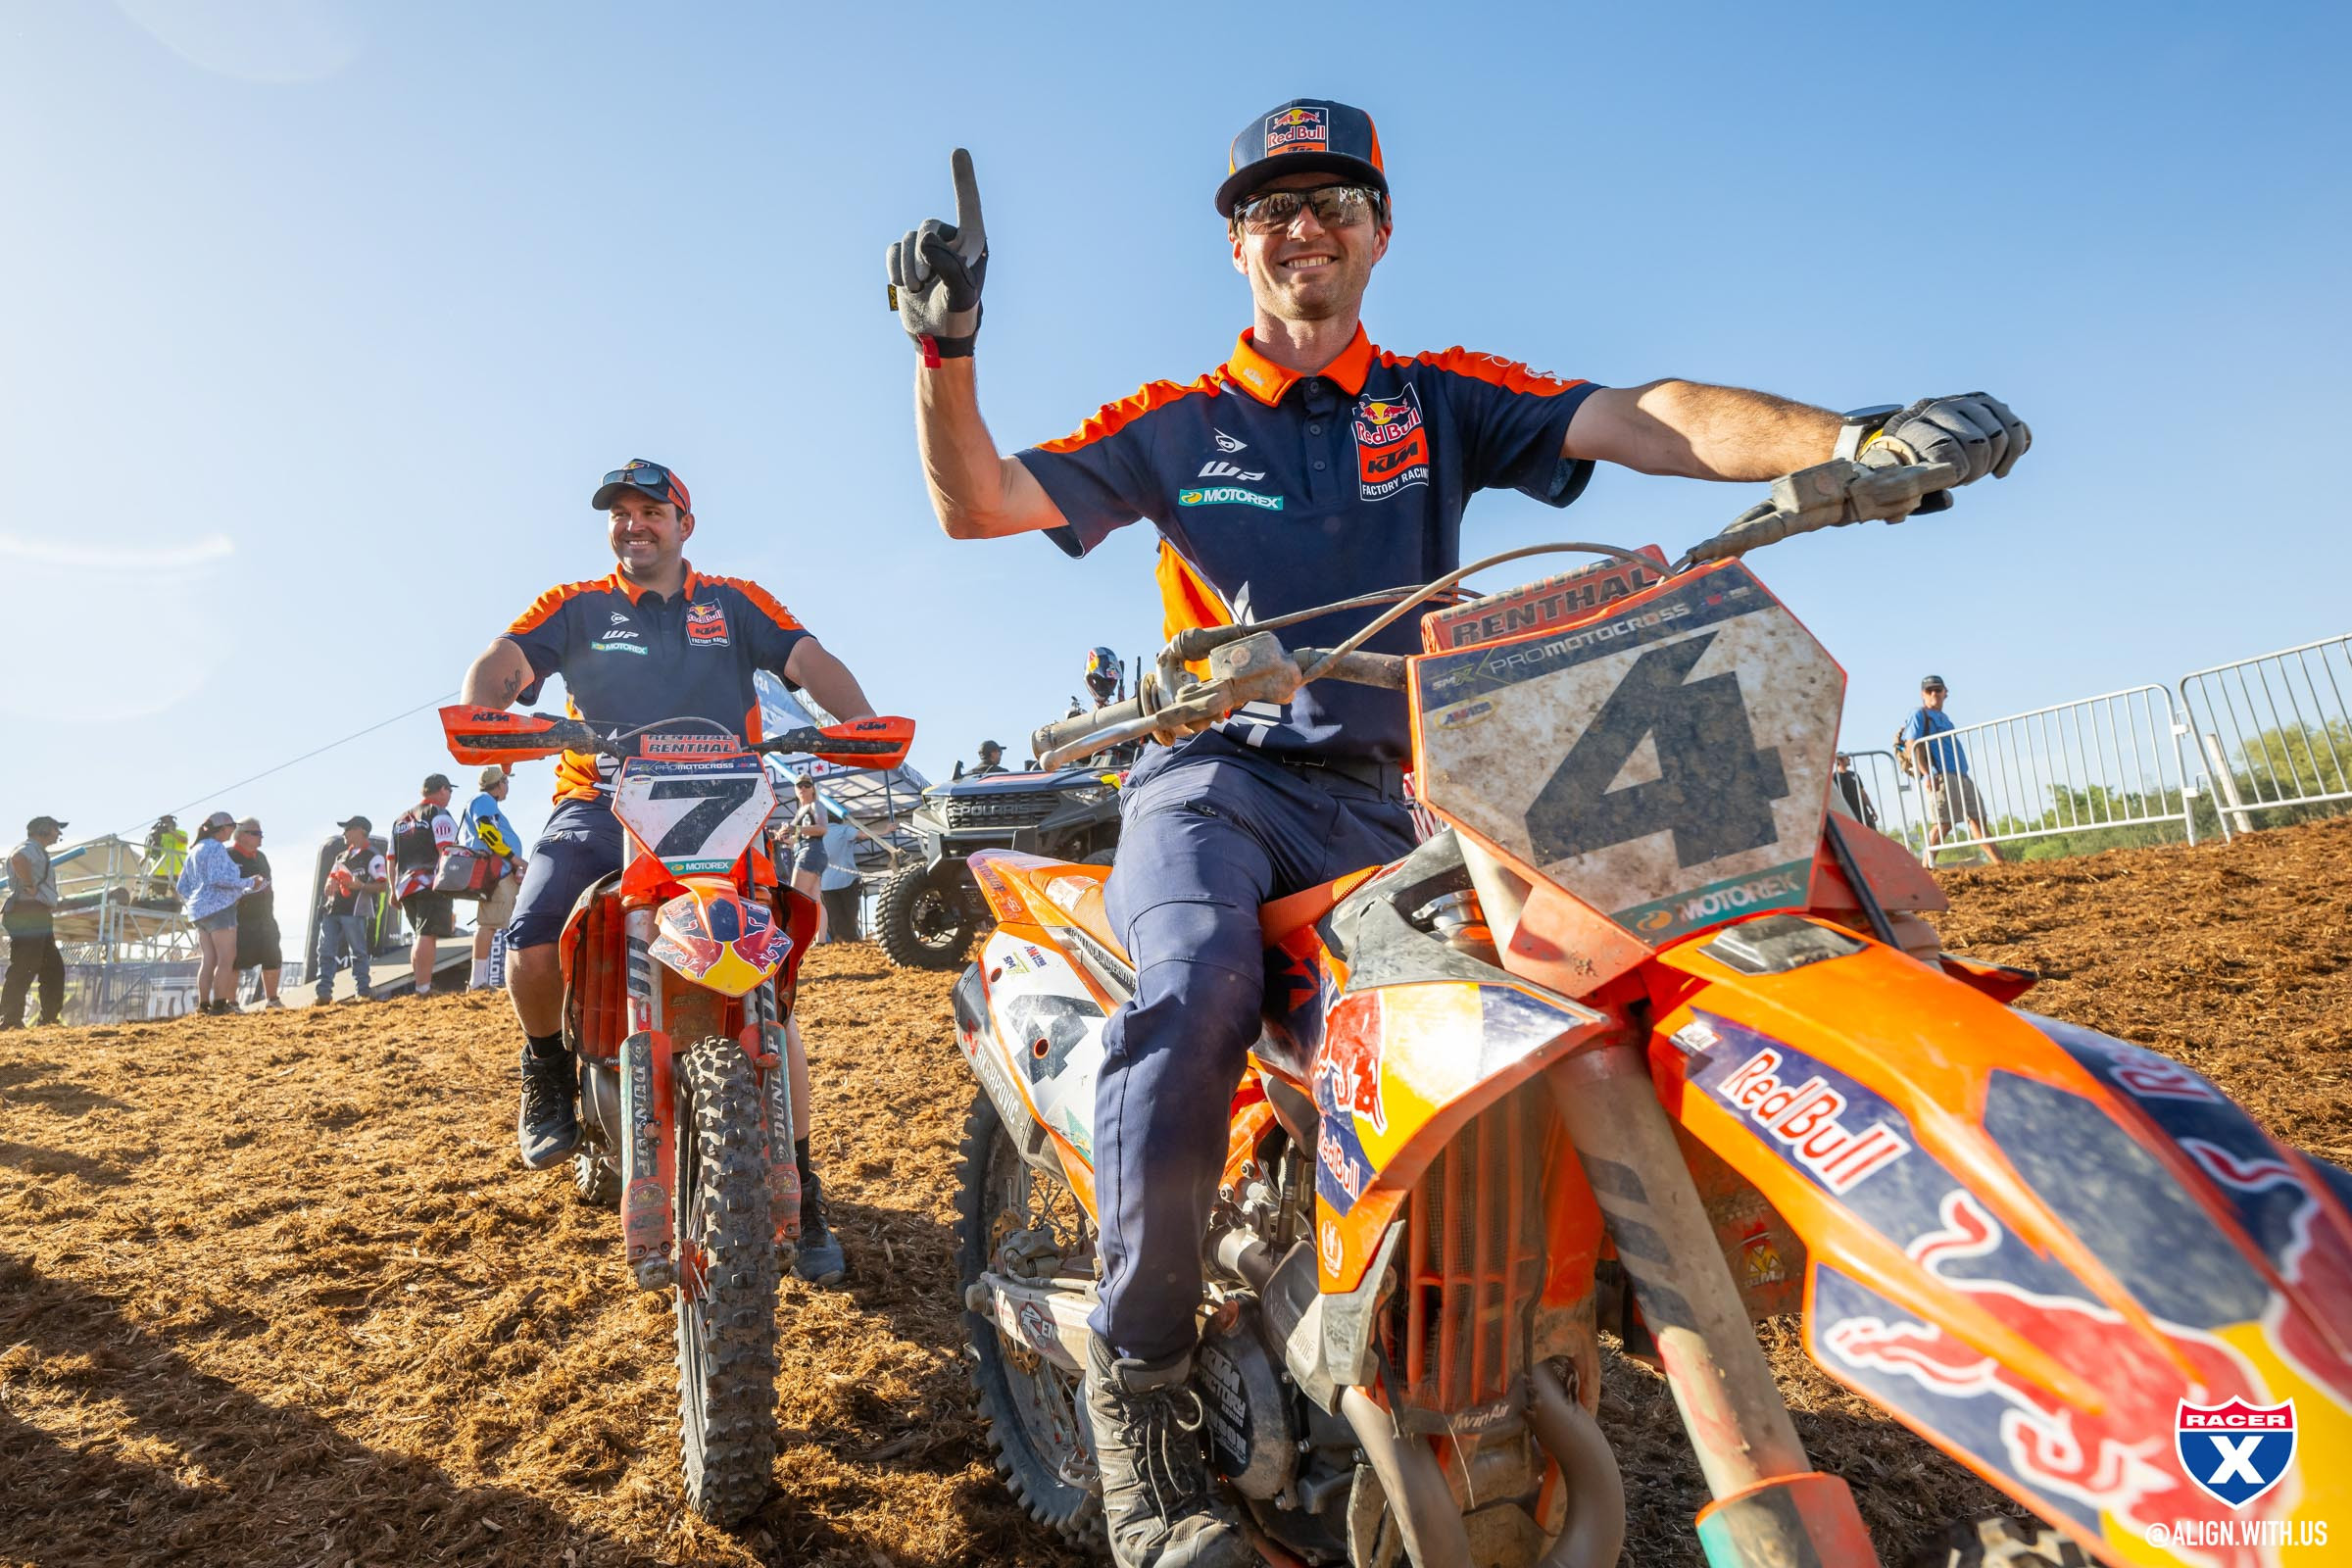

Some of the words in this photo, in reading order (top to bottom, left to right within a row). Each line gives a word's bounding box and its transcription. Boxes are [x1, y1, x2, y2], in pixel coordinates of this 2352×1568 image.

[1268, 126, 1296, 149] Red
[1296, 125, 1326, 140] Bull
[1355, 421, 1387, 444] Red
[1385, 408, 1421, 441] Bull
[1367, 441, 1419, 473] KTM
[1203, 488, 1279, 509] MOTOREX
[1361, 478, 1398, 496] FACTORY
[1450, 567, 1659, 648] RENTHAL
[606, 642, 646, 654] MOTOREX
[471, 711, 510, 722] KTM
[856, 722, 887, 731] KTM
[648, 742, 734, 754] RENTHAL
[1525, 630, 1790, 869] 4
[648, 778, 759, 858] 7
[960, 804, 1028, 816] POLARIS
[686, 861, 730, 872] MOTOREX
[1675, 871, 1801, 924] MOTOREX
[1717, 1047, 1830, 1129] Red
[1768, 1087, 1912, 1197] Bull
[1317, 1117, 1338, 1174] Red
[1334, 1142, 1360, 1201] Bull
[1200, 1346, 1240, 1395] KTM
